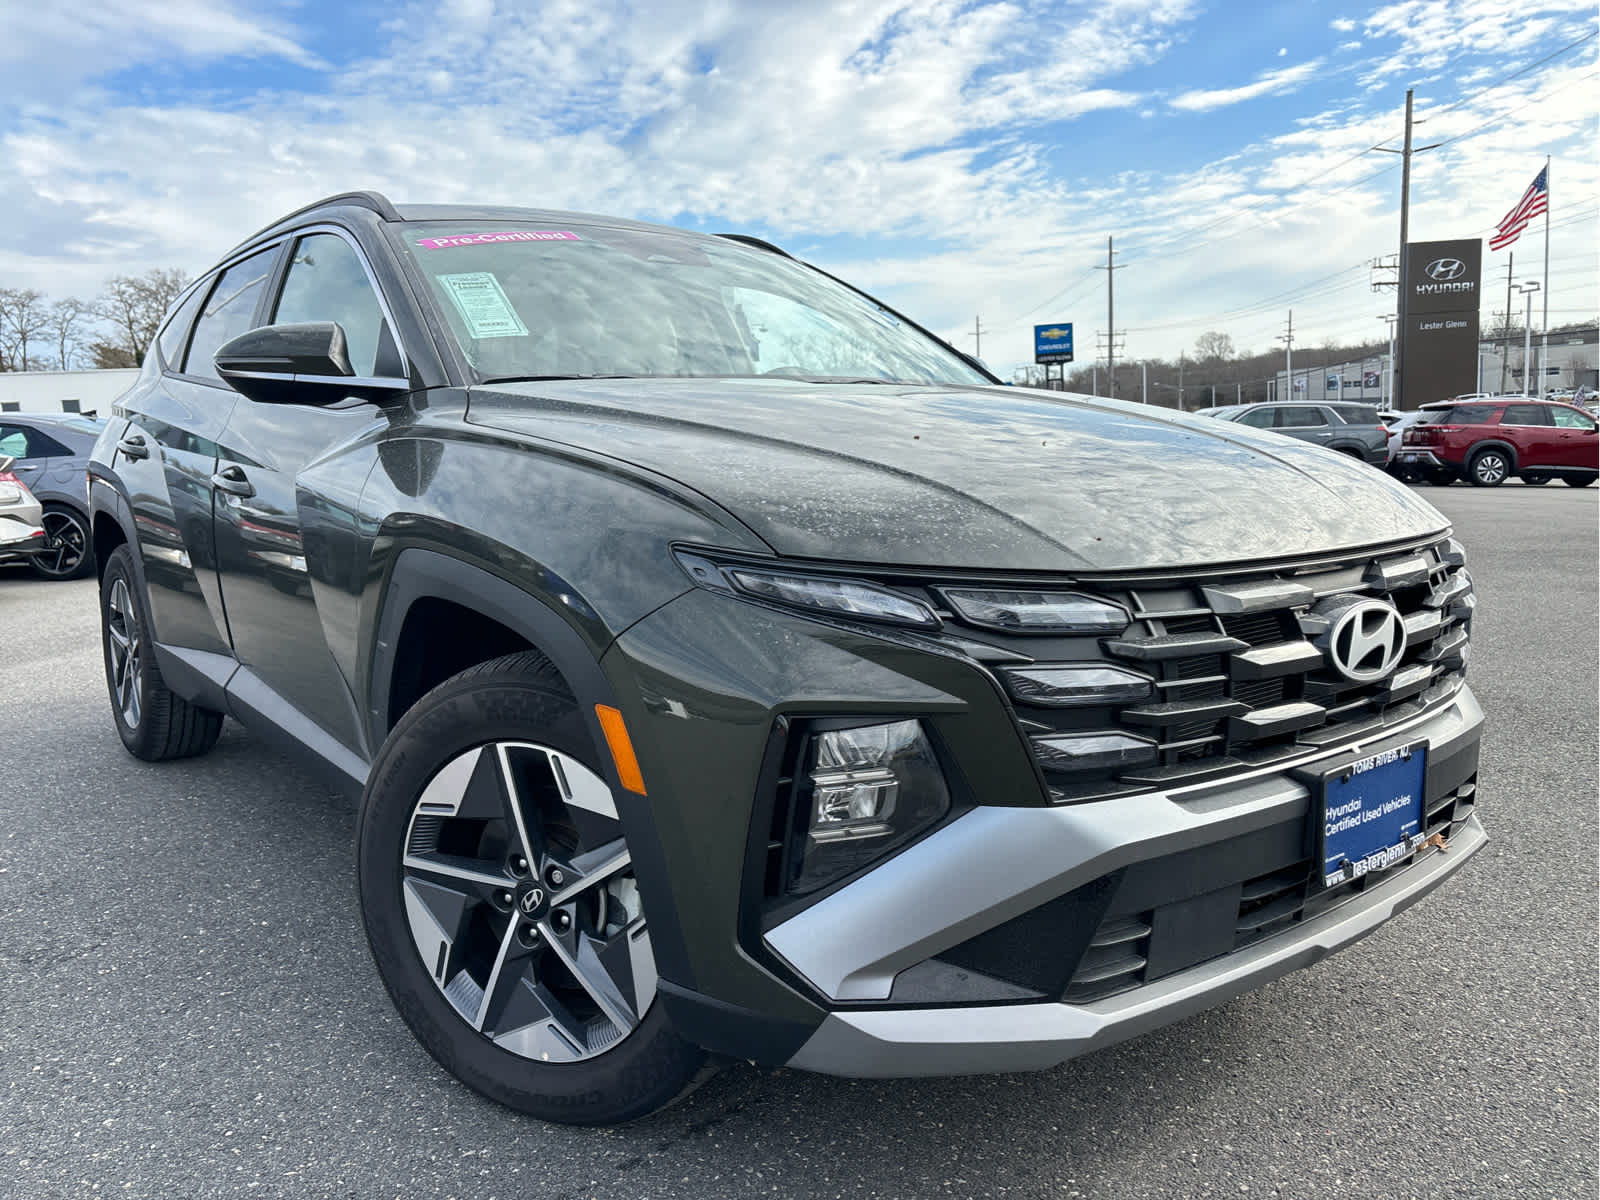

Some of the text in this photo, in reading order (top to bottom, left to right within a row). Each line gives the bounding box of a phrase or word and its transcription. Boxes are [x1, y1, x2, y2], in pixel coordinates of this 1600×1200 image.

[433, 232, 567, 246] Pre-Certified
[1416, 282, 1474, 294] HYUNDAI
[1420, 320, 1467, 330] Lester Glenn
[1352, 760, 1374, 775] TOMS
[1325, 797, 1362, 821] Hyundai
[1325, 795, 1411, 836] Certified Used Vehicles
